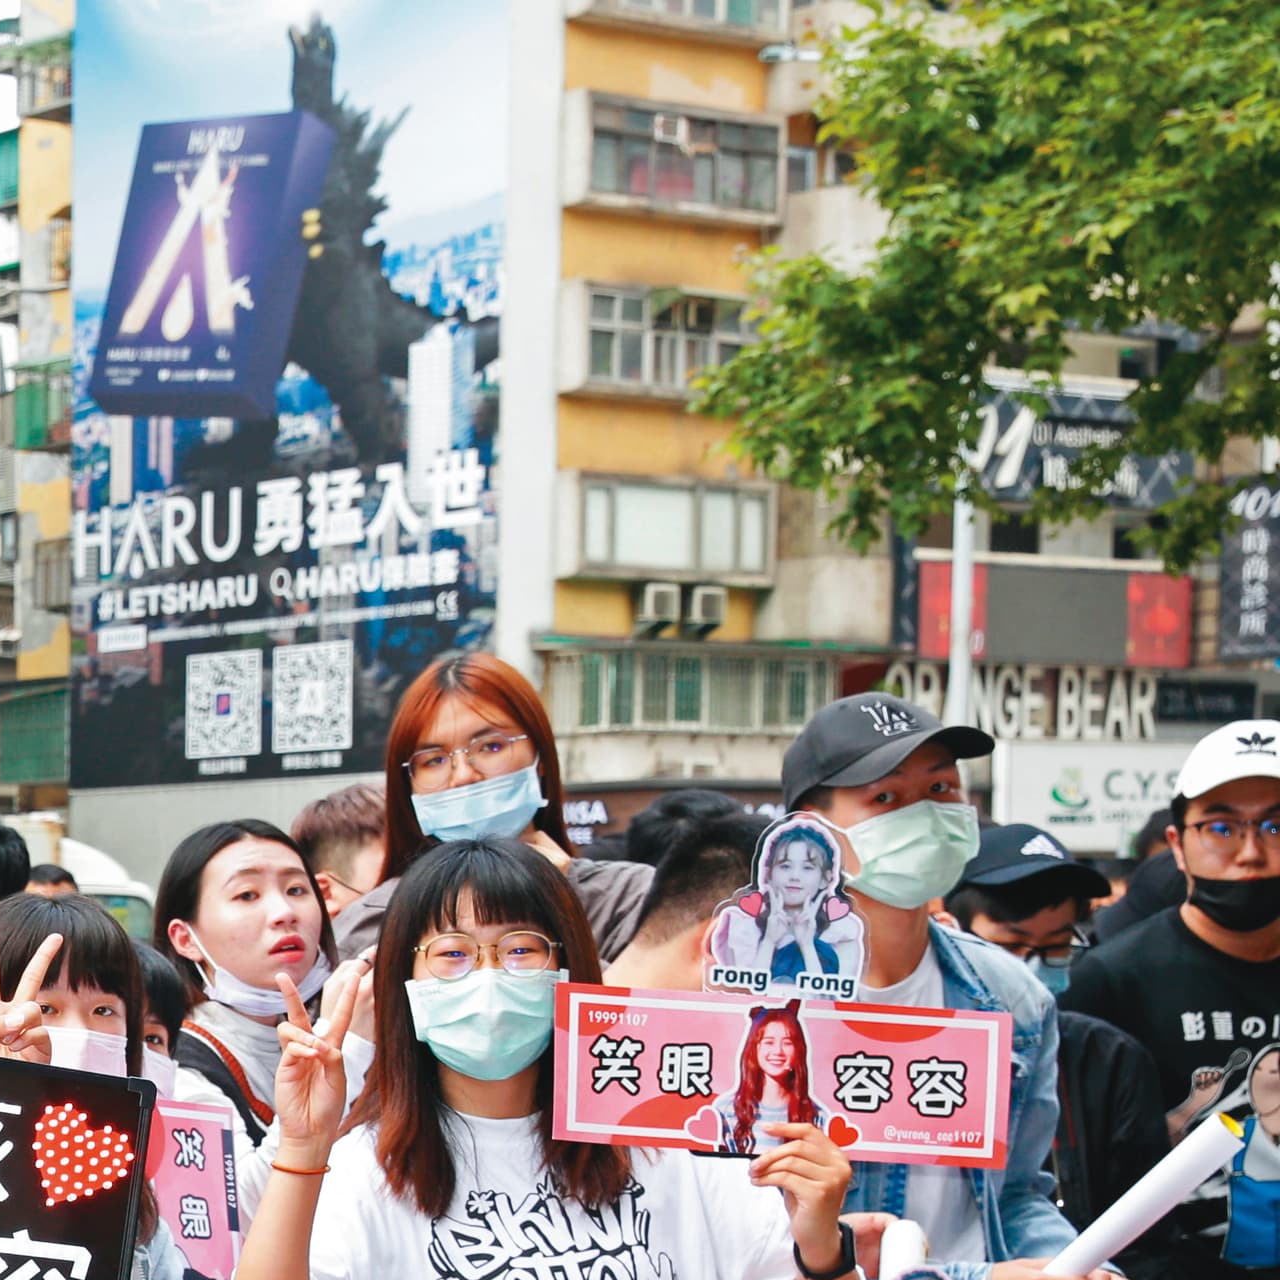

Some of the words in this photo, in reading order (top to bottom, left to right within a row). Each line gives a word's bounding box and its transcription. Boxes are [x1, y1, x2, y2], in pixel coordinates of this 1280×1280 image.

[73, 487, 243, 580] HARU
[253, 446, 486, 557] 勇猛入世
[97, 574, 259, 622] #LETSHARU
[1240, 527, 1271, 637] 時尚診所
[884, 661, 1043, 738] ORNGE
[1056, 667, 1158, 741] BEAR
[712, 966, 768, 993] rong
[798, 974, 855, 999] rong
[587, 1009, 649, 1026] 19991107
[590, 1035, 712, 1097] 笑眼
[834, 1052, 968, 1117] 容容
[224, 1153, 237, 1209] 19991107
